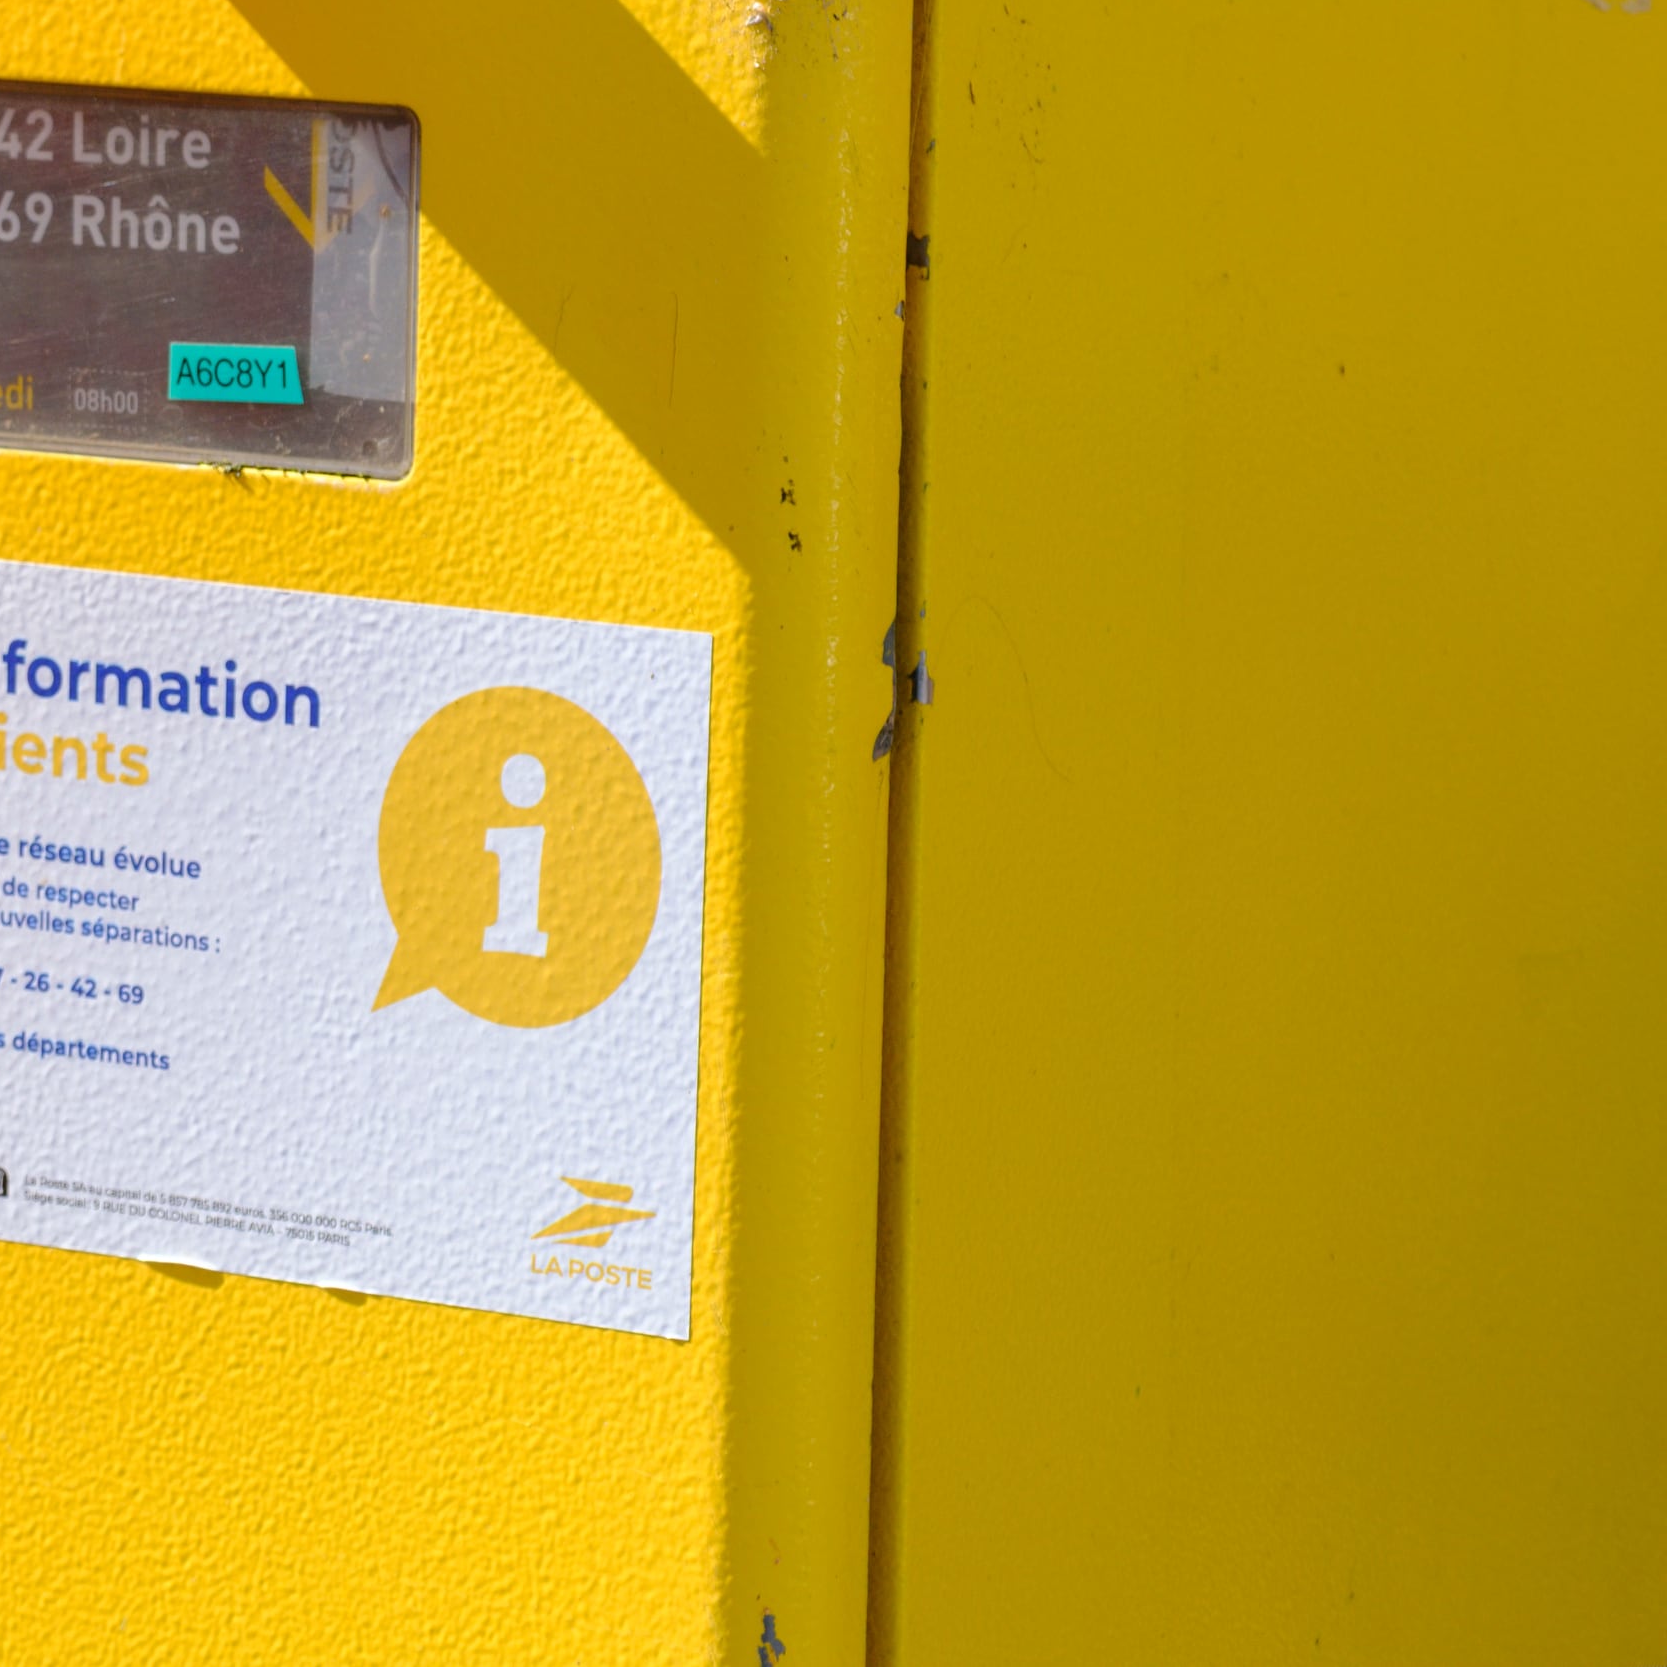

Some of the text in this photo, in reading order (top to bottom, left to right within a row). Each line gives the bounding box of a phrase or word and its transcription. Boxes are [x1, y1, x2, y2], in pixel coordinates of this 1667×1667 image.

[73, 111, 212, 170] Loire
[72, 194, 241, 255] Rhône
[176, 357, 289, 390] A6C8Y1
[73, 388, 139, 416] 08h00
[18, 836, 105, 867] réseau
[113, 846, 202, 879] évolue
[2, 876, 29, 898] de
[36, 884, 140, 912] respecter
[81, 917, 210, 952] séparations
[23, 971, 51, 993] 26
[70, 977, 98, 998] 42
[118, 983, 145, 1005] 69
[12, 1031, 171, 1071] départements
[128, 1204, 147, 1217] DU
[148, 1206, 203, 1226] COLONEL
[205, 1214, 246, 1232] PIERRE
[248, 1221, 275, 1236] AVIA
[317, 1231, 351, 1247] PARIS
[530, 1252, 653, 1291] LA POSTE
